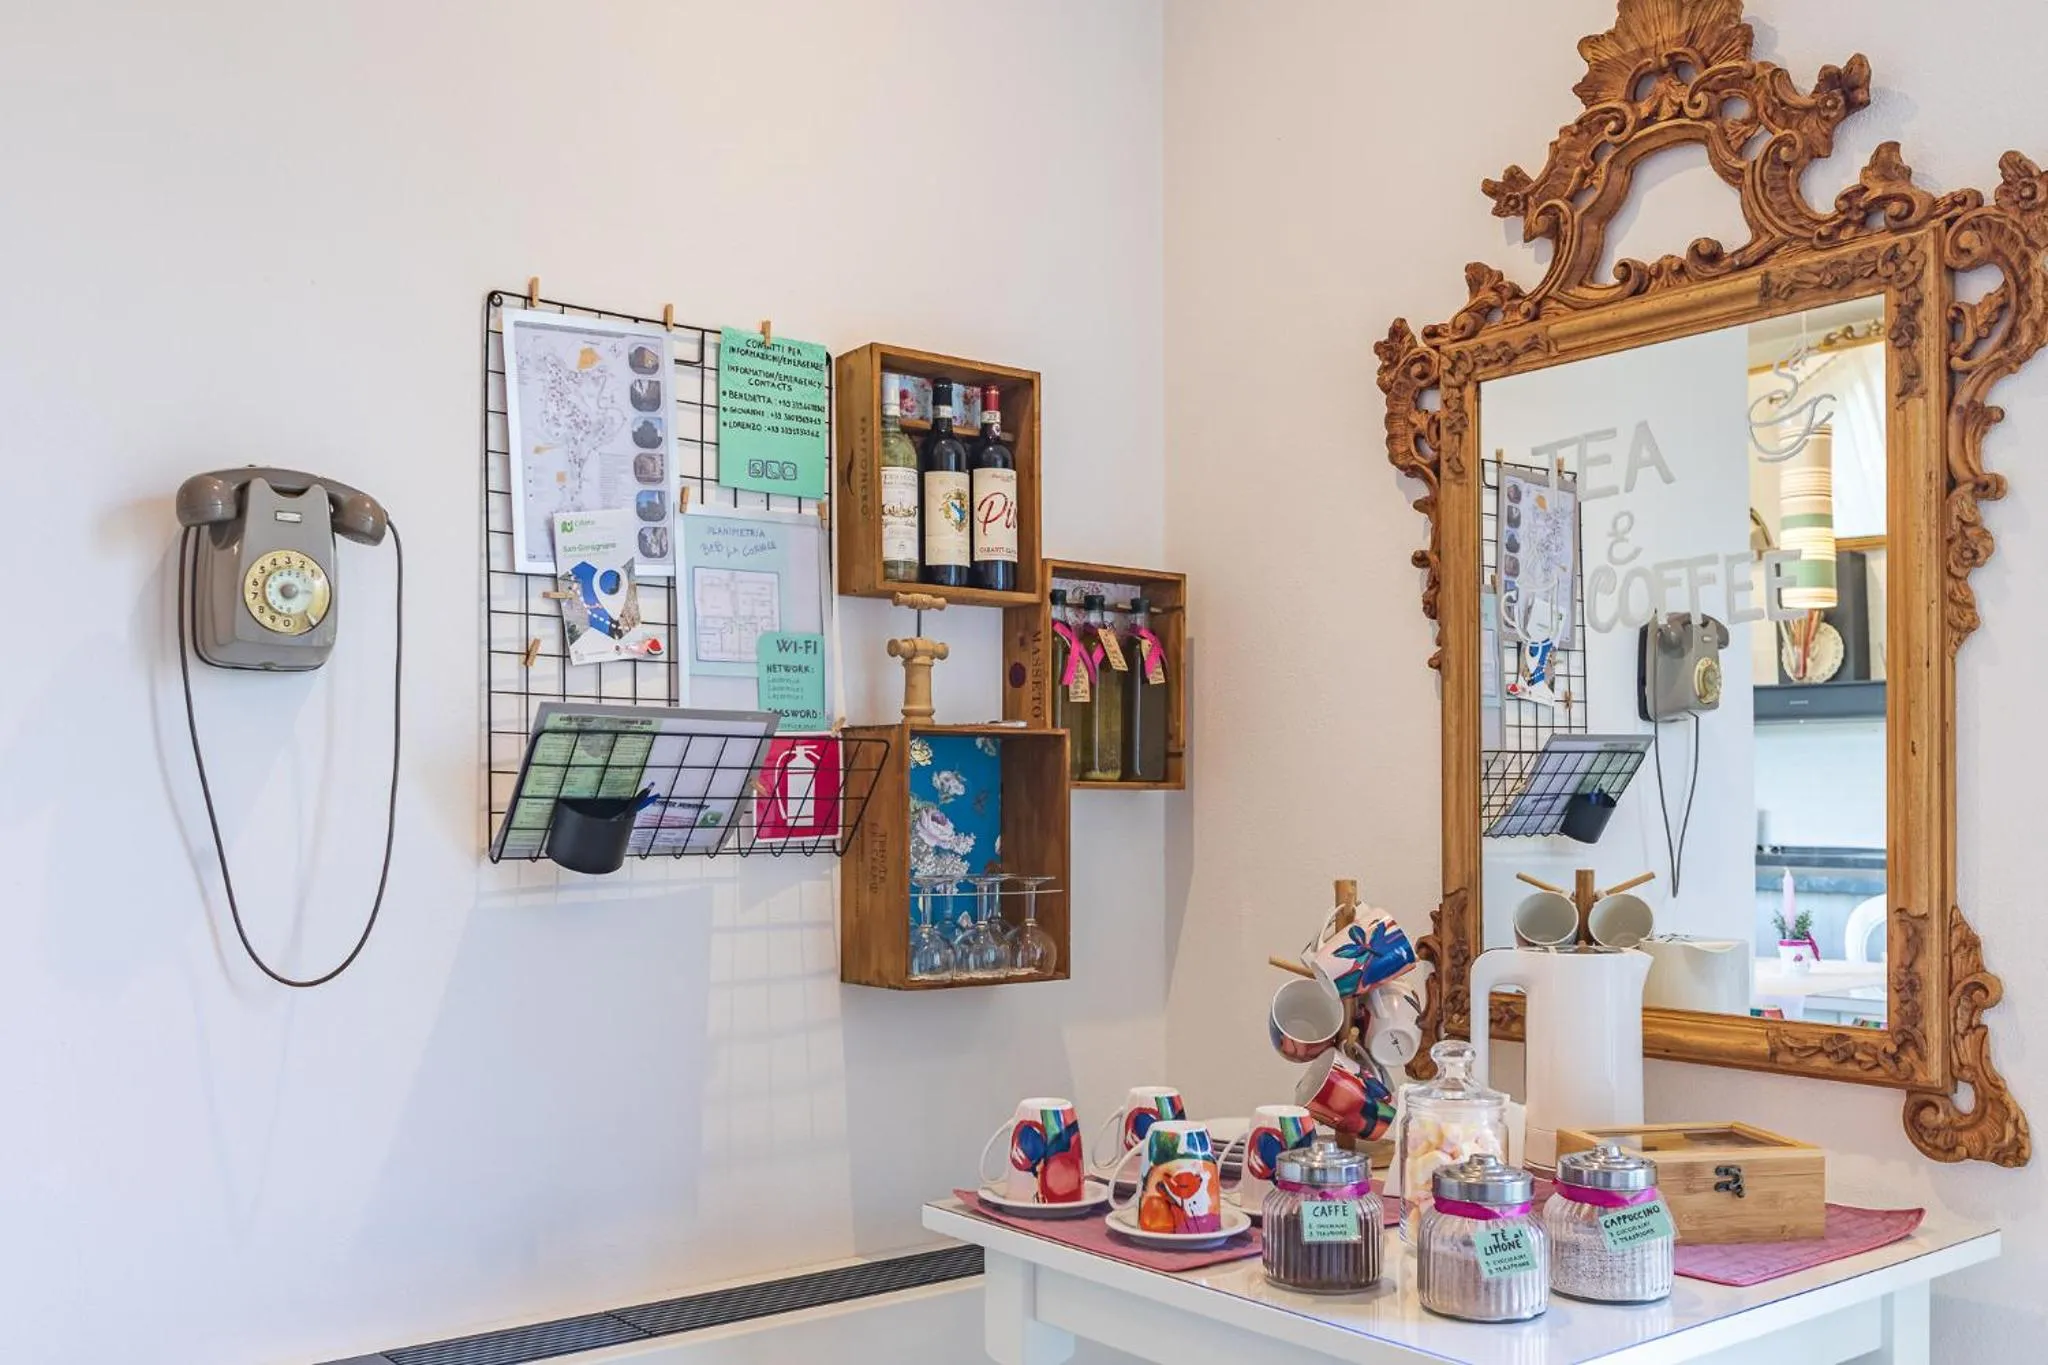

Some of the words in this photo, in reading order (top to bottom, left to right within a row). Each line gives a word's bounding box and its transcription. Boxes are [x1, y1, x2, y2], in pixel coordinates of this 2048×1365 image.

[788, 346, 802, 357] PER
[747, 377, 793, 392] CONTACTS
[1531, 420, 1676, 506] TEA
[1606, 510, 1643, 566] &
[270, 558, 277, 566] 4
[285, 556, 292, 565] 3
[259, 566, 265, 574] 5
[252, 579, 259, 587] 6
[251, 592, 258, 600] 7
[1586, 549, 1805, 635] COFFEE
[258, 606, 264, 614] 8
[269, 615, 276, 623] 9
[283, 619, 290, 627] 0
[776, 639, 818, 655] WI-FI
[1030, 629, 1042, 719] MASSETO
[1312, 1199, 1349, 1217] CAFFÈ
[1603, 1204, 1661, 1229] CAPPUCCINO
[1483, 1239, 1523, 1257] LIMONE
